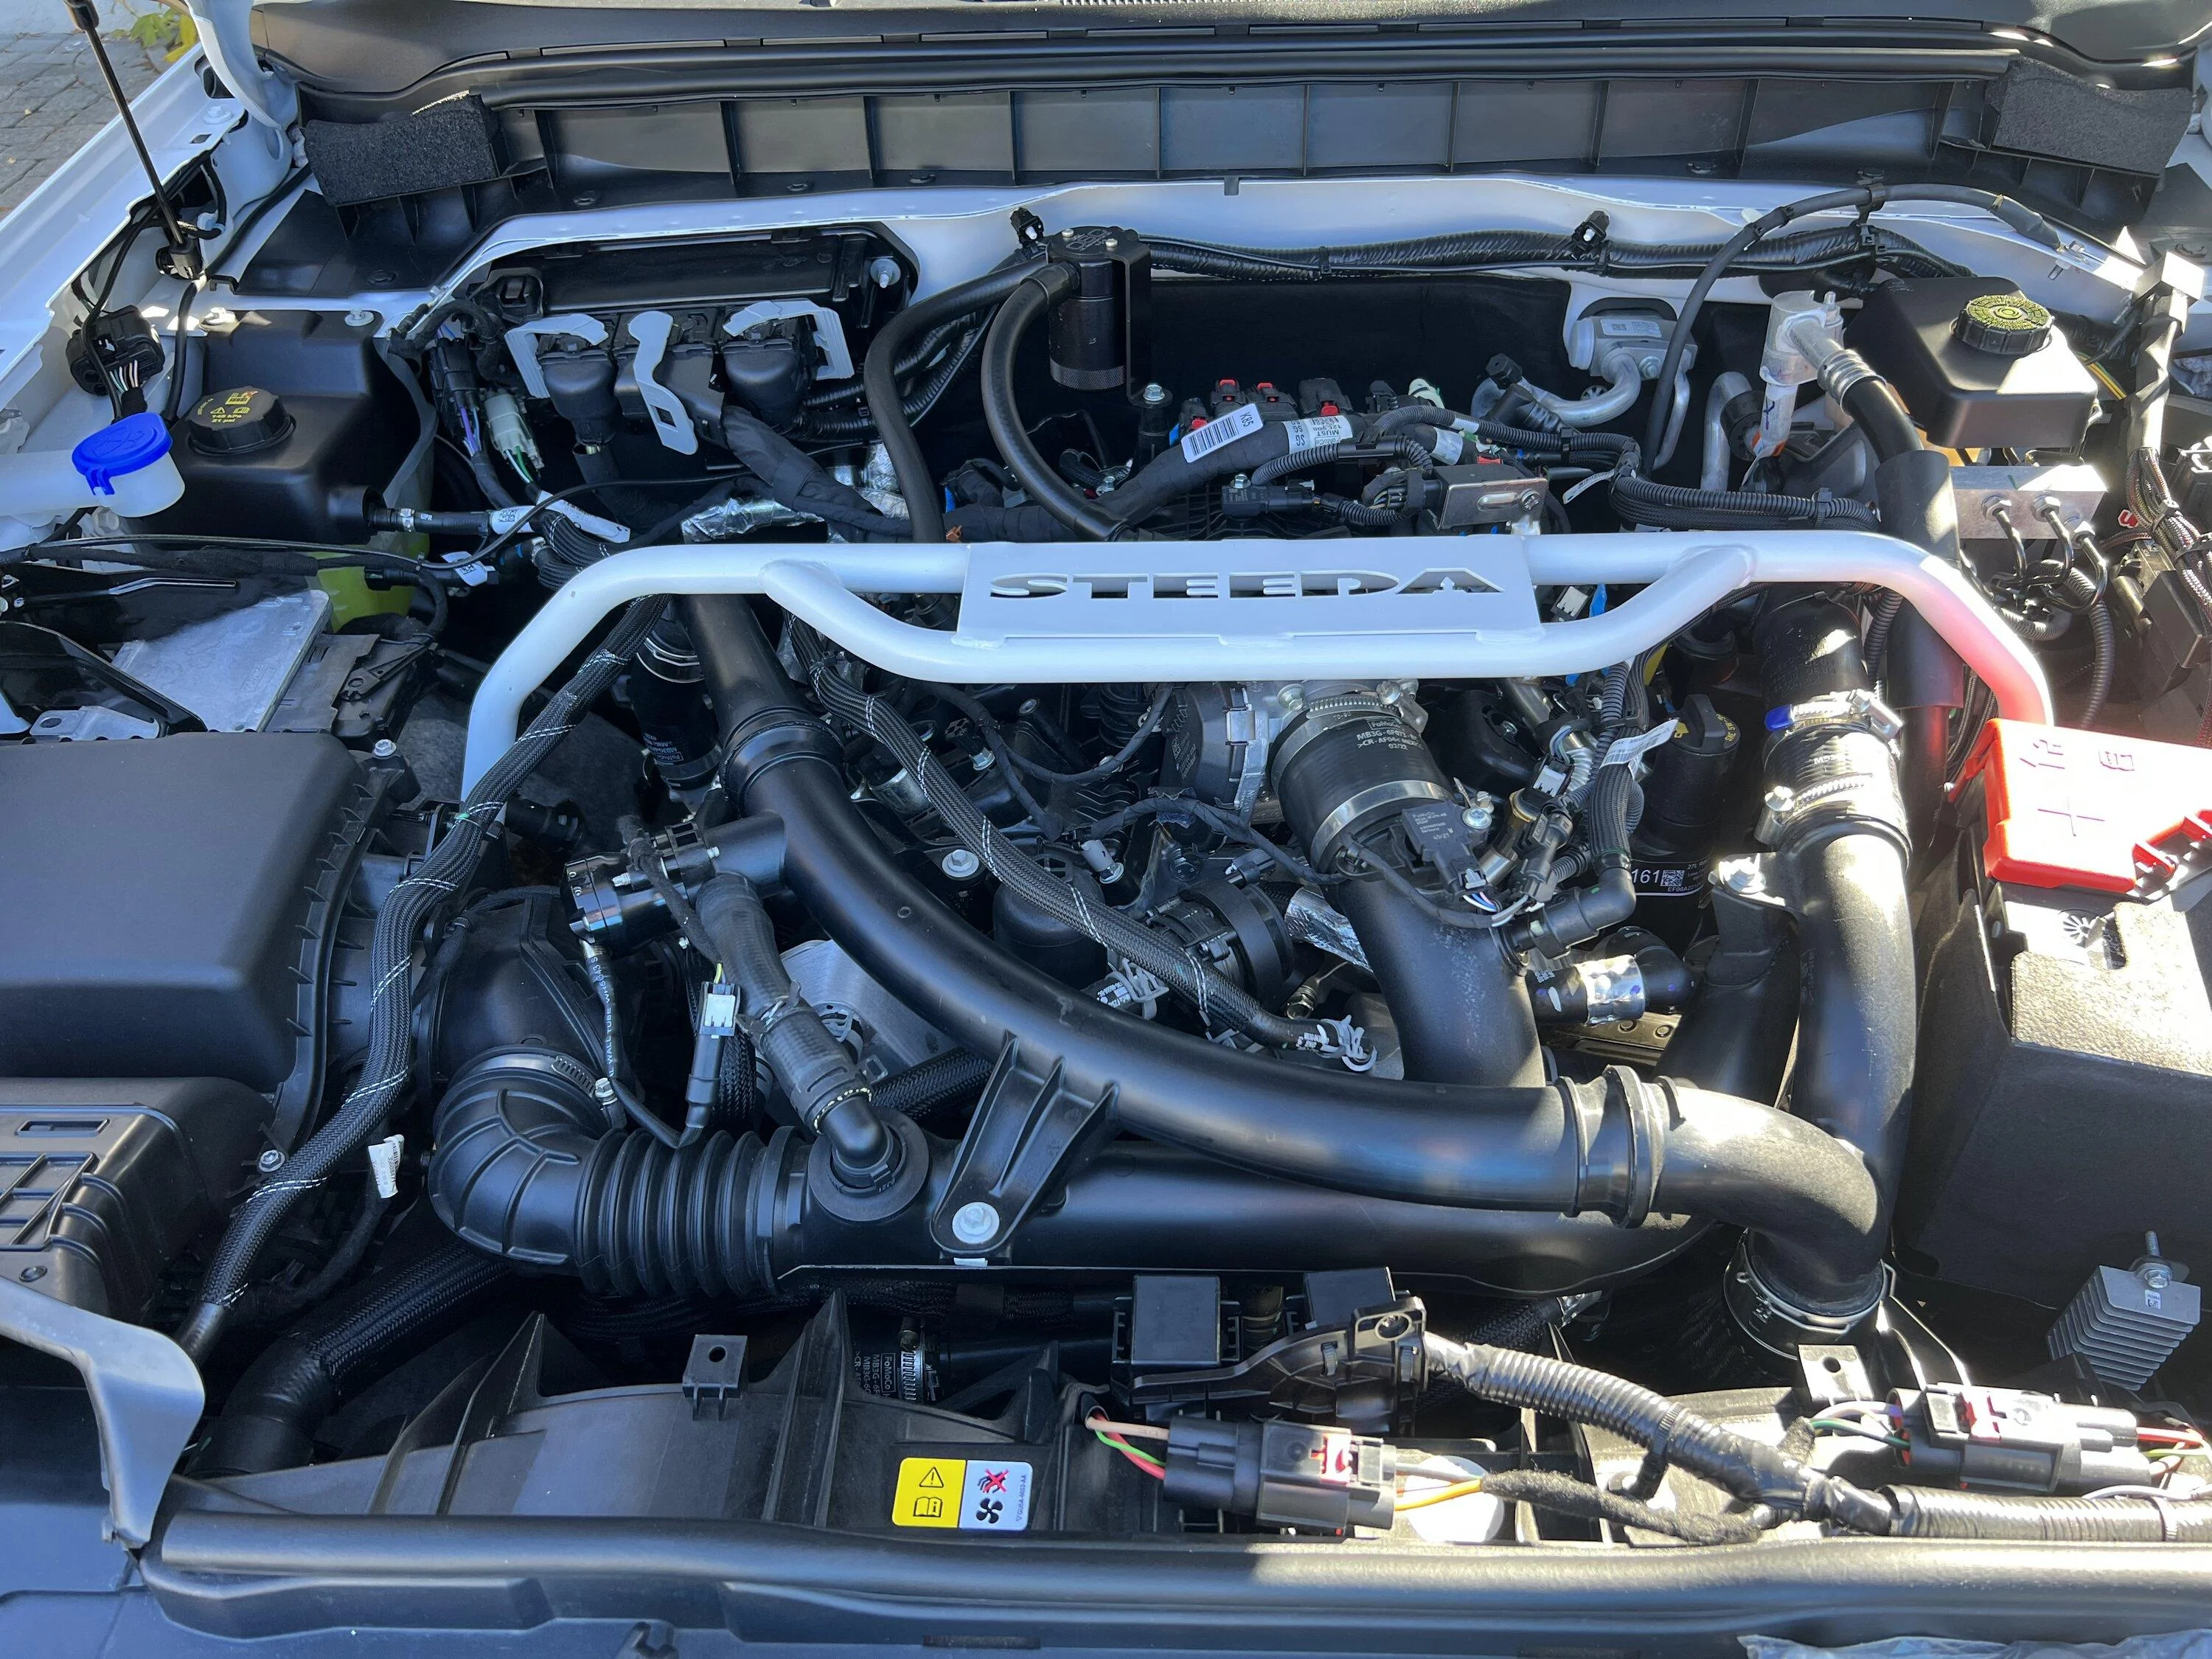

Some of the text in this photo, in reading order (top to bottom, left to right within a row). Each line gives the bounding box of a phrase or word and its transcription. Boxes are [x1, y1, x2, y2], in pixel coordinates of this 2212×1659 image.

[1239, 411, 1254, 428] K85
[1293, 425, 1304, 434] SG
[1295, 434, 1306, 446] SG
[990, 567, 1506, 599] STEEDA
[1631, 869, 1660, 883] 161
[605, 1036, 613, 1064] WALL
[884, 1356, 892, 1390] FoMoCo
